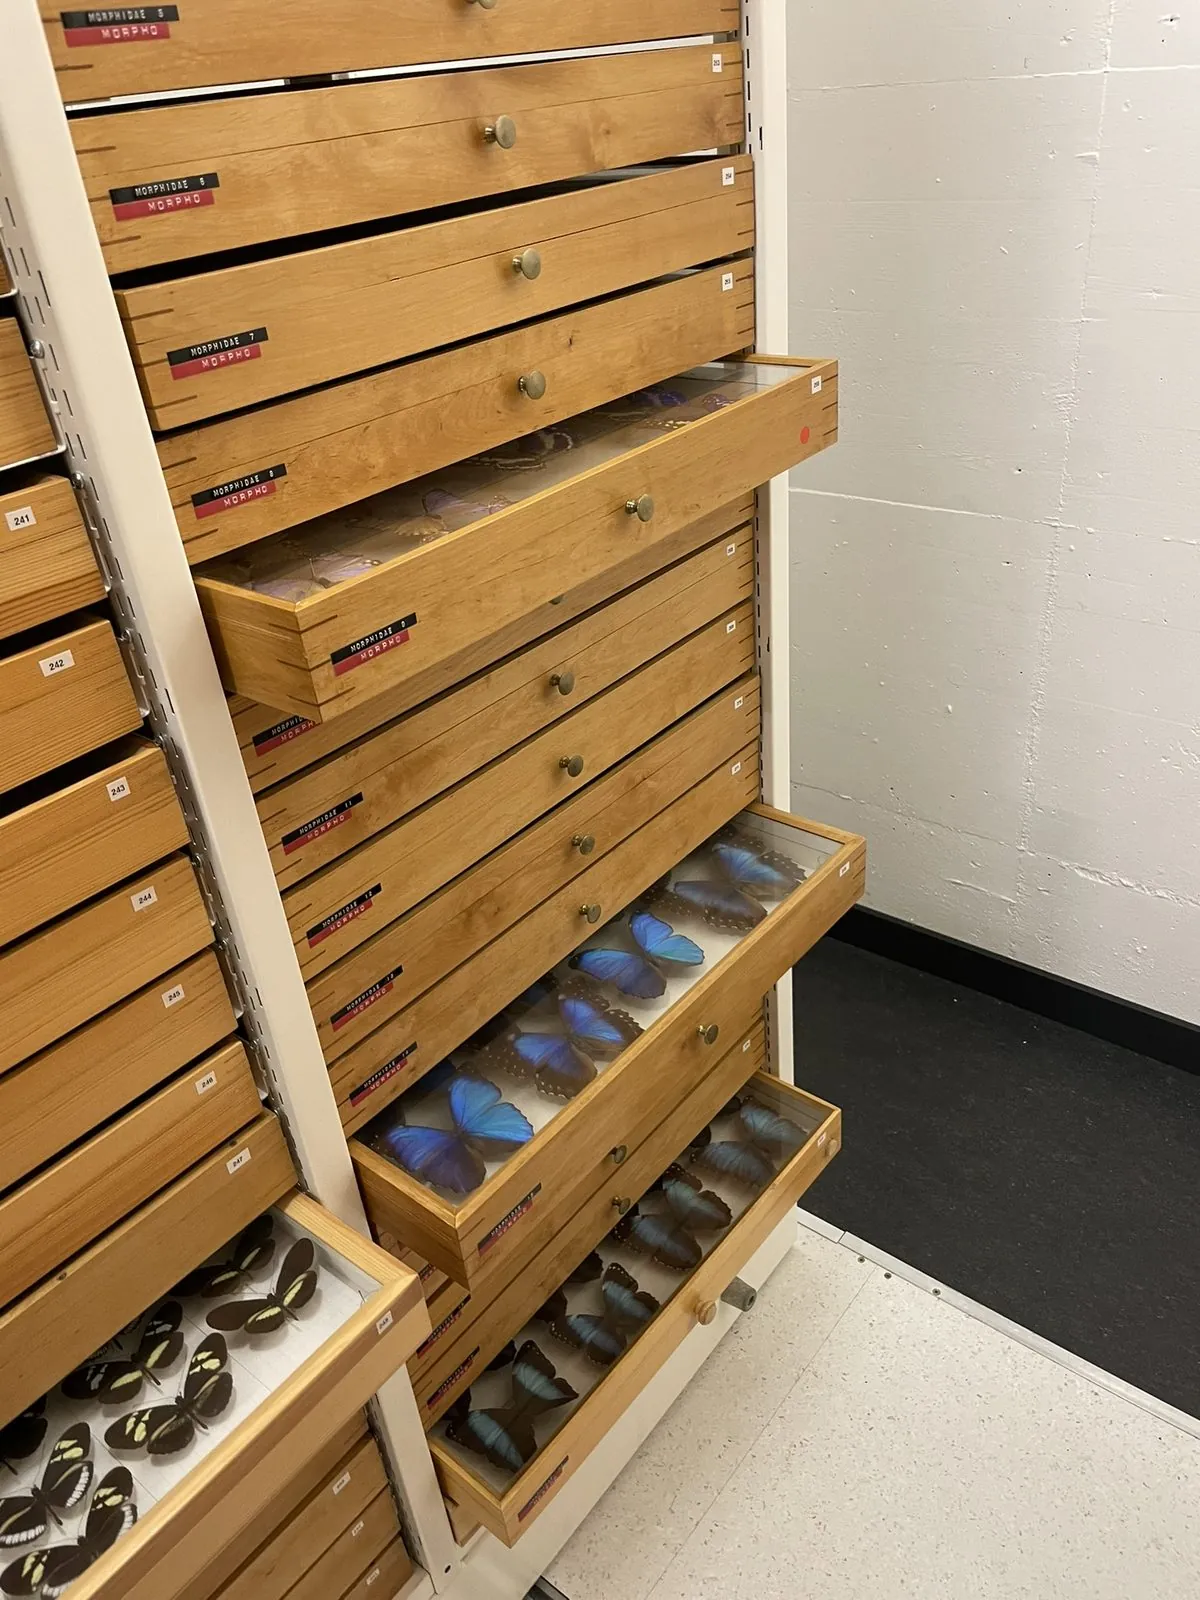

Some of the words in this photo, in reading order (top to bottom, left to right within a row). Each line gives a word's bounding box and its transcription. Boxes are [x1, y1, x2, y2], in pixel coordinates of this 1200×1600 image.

[88, 9, 146, 23] MORPHIDAE
[101, 25, 157, 39] MORPHO
[135, 179, 188, 197] MORPHIDAE
[148, 194, 200, 211] MORPHO
[191, 336, 240, 356] MORPHIDAE
[249, 333, 255, 341] 7
[201, 349, 250, 368] MORPHO
[213, 475, 260, 497] MORPHIDAE
[223, 485, 268, 506] MORPHO
[14, 514, 30, 526] 241
[350, 627, 392, 653] MORPHIDAE
[361, 635, 401, 660] MORPHO
[49, 659, 64, 670] 242
[111, 785, 125, 796] 243
[300, 809, 337, 834] MORPHIDAE
[307, 814, 345, 839] MORPHO
[139, 893, 152, 904] 244
[331, 905, 365, 931] MORPHO
